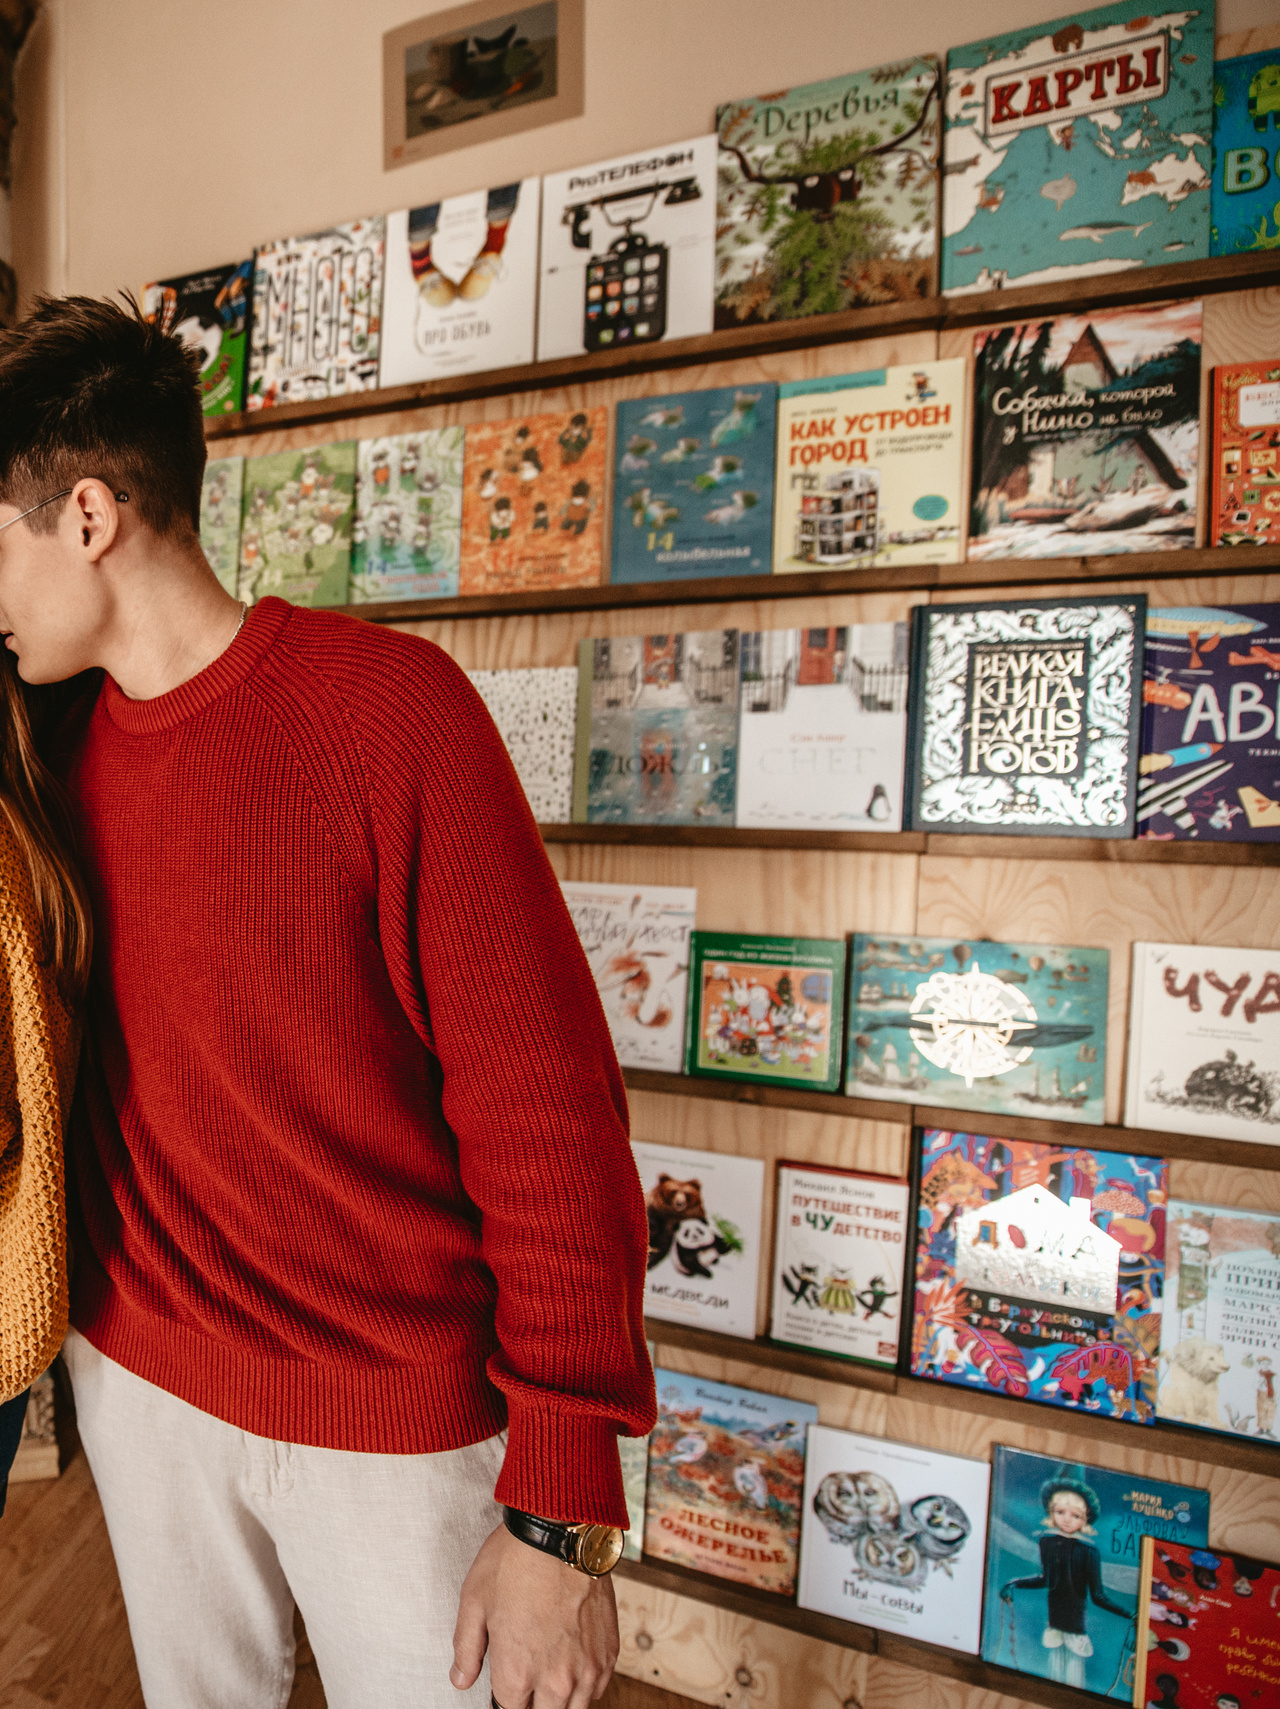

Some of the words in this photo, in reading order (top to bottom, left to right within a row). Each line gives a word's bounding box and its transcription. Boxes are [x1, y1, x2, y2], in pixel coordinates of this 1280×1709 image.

[991, 46, 1162, 124] КАРТЫ
[755, 84, 900, 145] Деревья
[1224, 147, 1280, 194] В
[1099, 383, 1177, 405] которой
[790, 418, 836, 441] КАК
[844, 404, 951, 434] УСТРОЕН
[1022, 410, 1094, 434] Нино
[1099, 412, 1119, 425] не
[1122, 404, 1163, 421] было
[790, 438, 869, 466] ГОРОД
[646, 532, 674, 551] 14
[974, 649, 1086, 678] ВЕЛИКАЯ
[972, 674, 1086, 712] КНИГА
[1181, 681, 1280, 743] АВ
[507, 729, 535, 744] ес
[759, 748, 878, 776] СНЕГ
[970, 738, 1080, 774] РОГОВ
[794, 1179, 837, 1193] Михаил
[840, 1185, 875, 1199] Яснов
[792, 1194, 901, 1223] ПУТЕШЕСТВИЕ
[805, 1212, 902, 1244] ЧУДЕТСТВО
[1131, 1490, 1162, 1507] МАРИЯ
[1132, 1502, 1175, 1521] ЛУЦЕНКО
[660, 1516, 788, 1564] ОЖЕРЕЛЬЕ
[678, 1509, 770, 1545] ЛЕСНОЕ
[843, 1580, 868, 1599] Мы
[1230, 1626, 1240, 1639] Я
